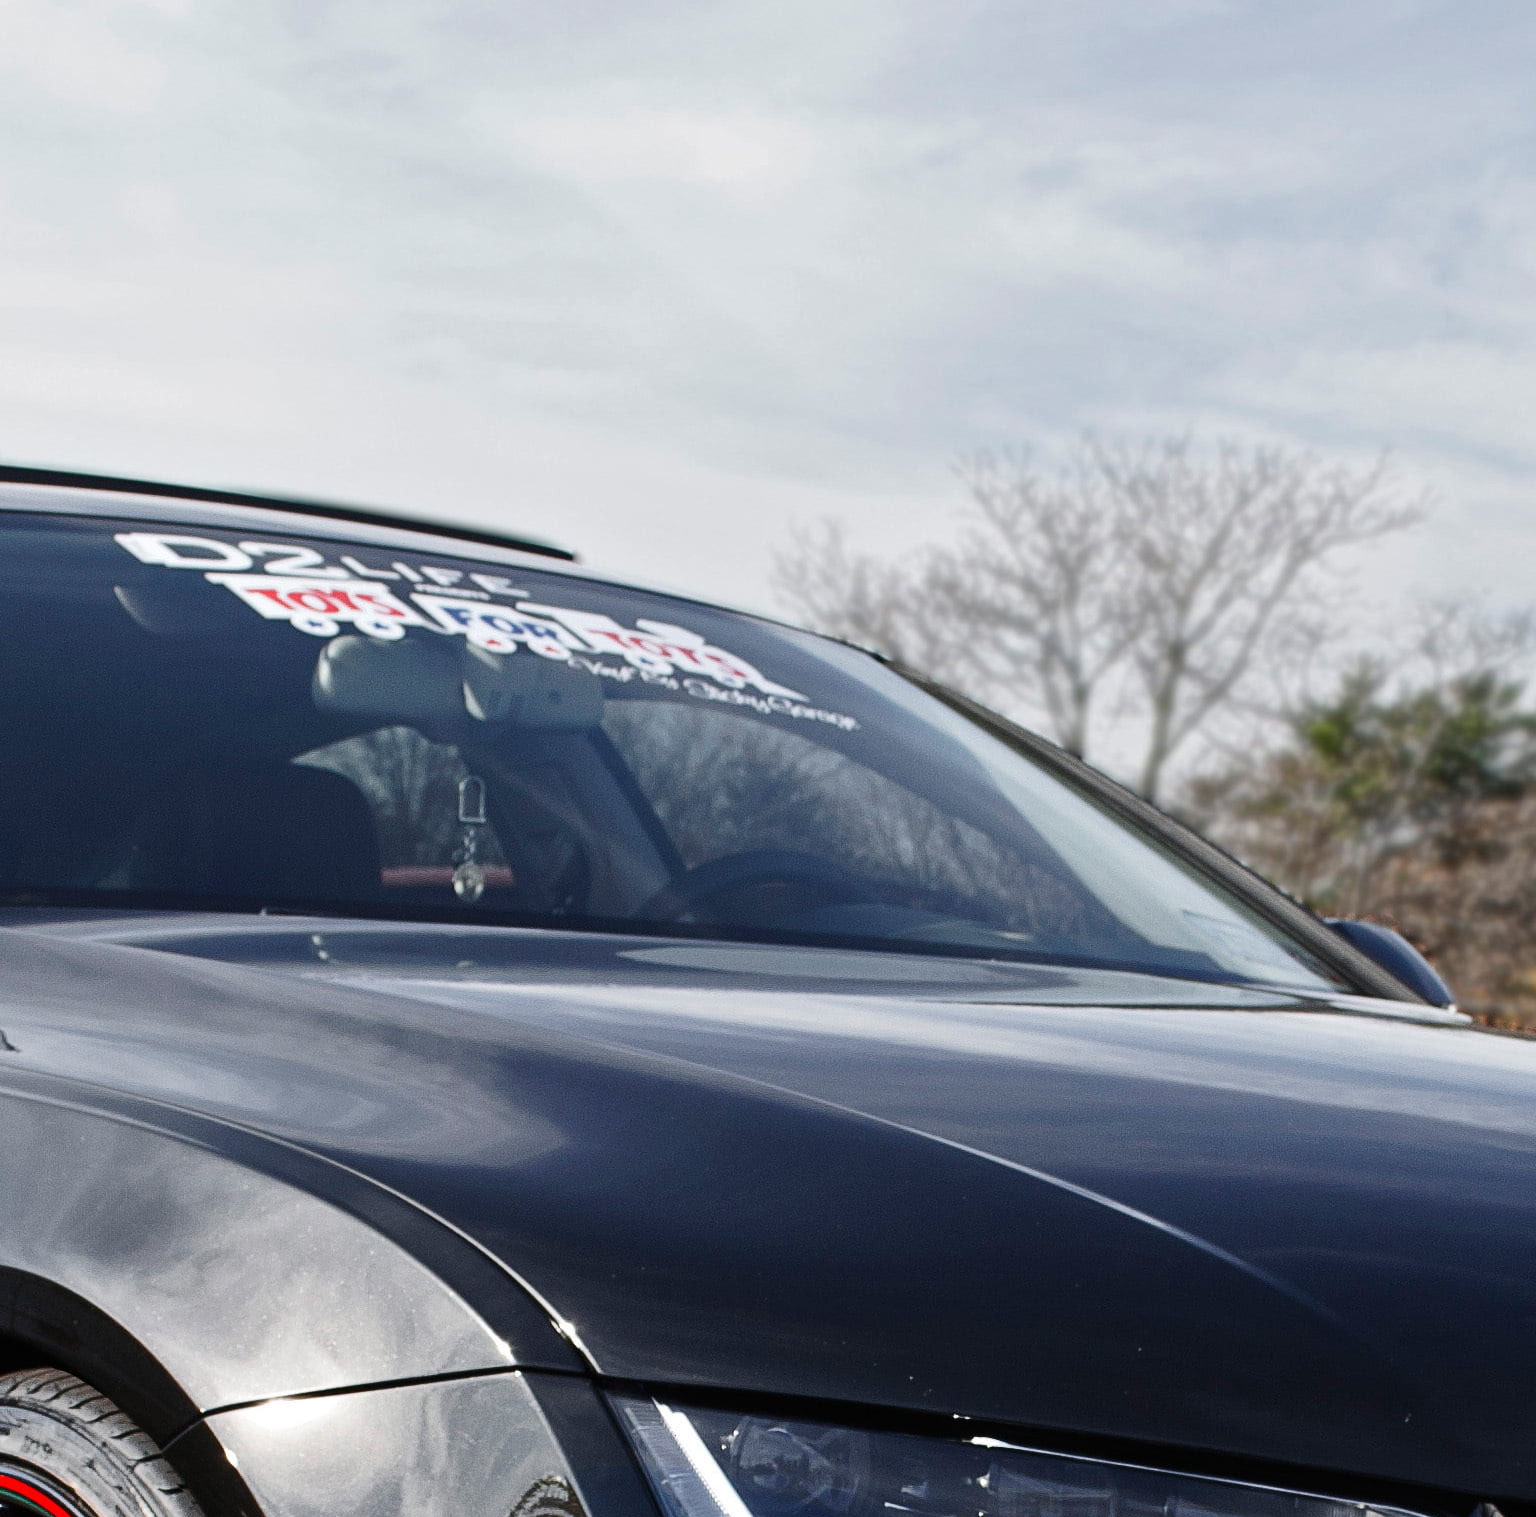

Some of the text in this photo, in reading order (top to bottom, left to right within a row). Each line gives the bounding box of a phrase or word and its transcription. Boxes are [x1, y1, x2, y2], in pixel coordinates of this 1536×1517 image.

[340, 556, 531, 599] LIFE
[244, 587, 407, 617] TOYS
[440, 604, 562, 643] FOR
